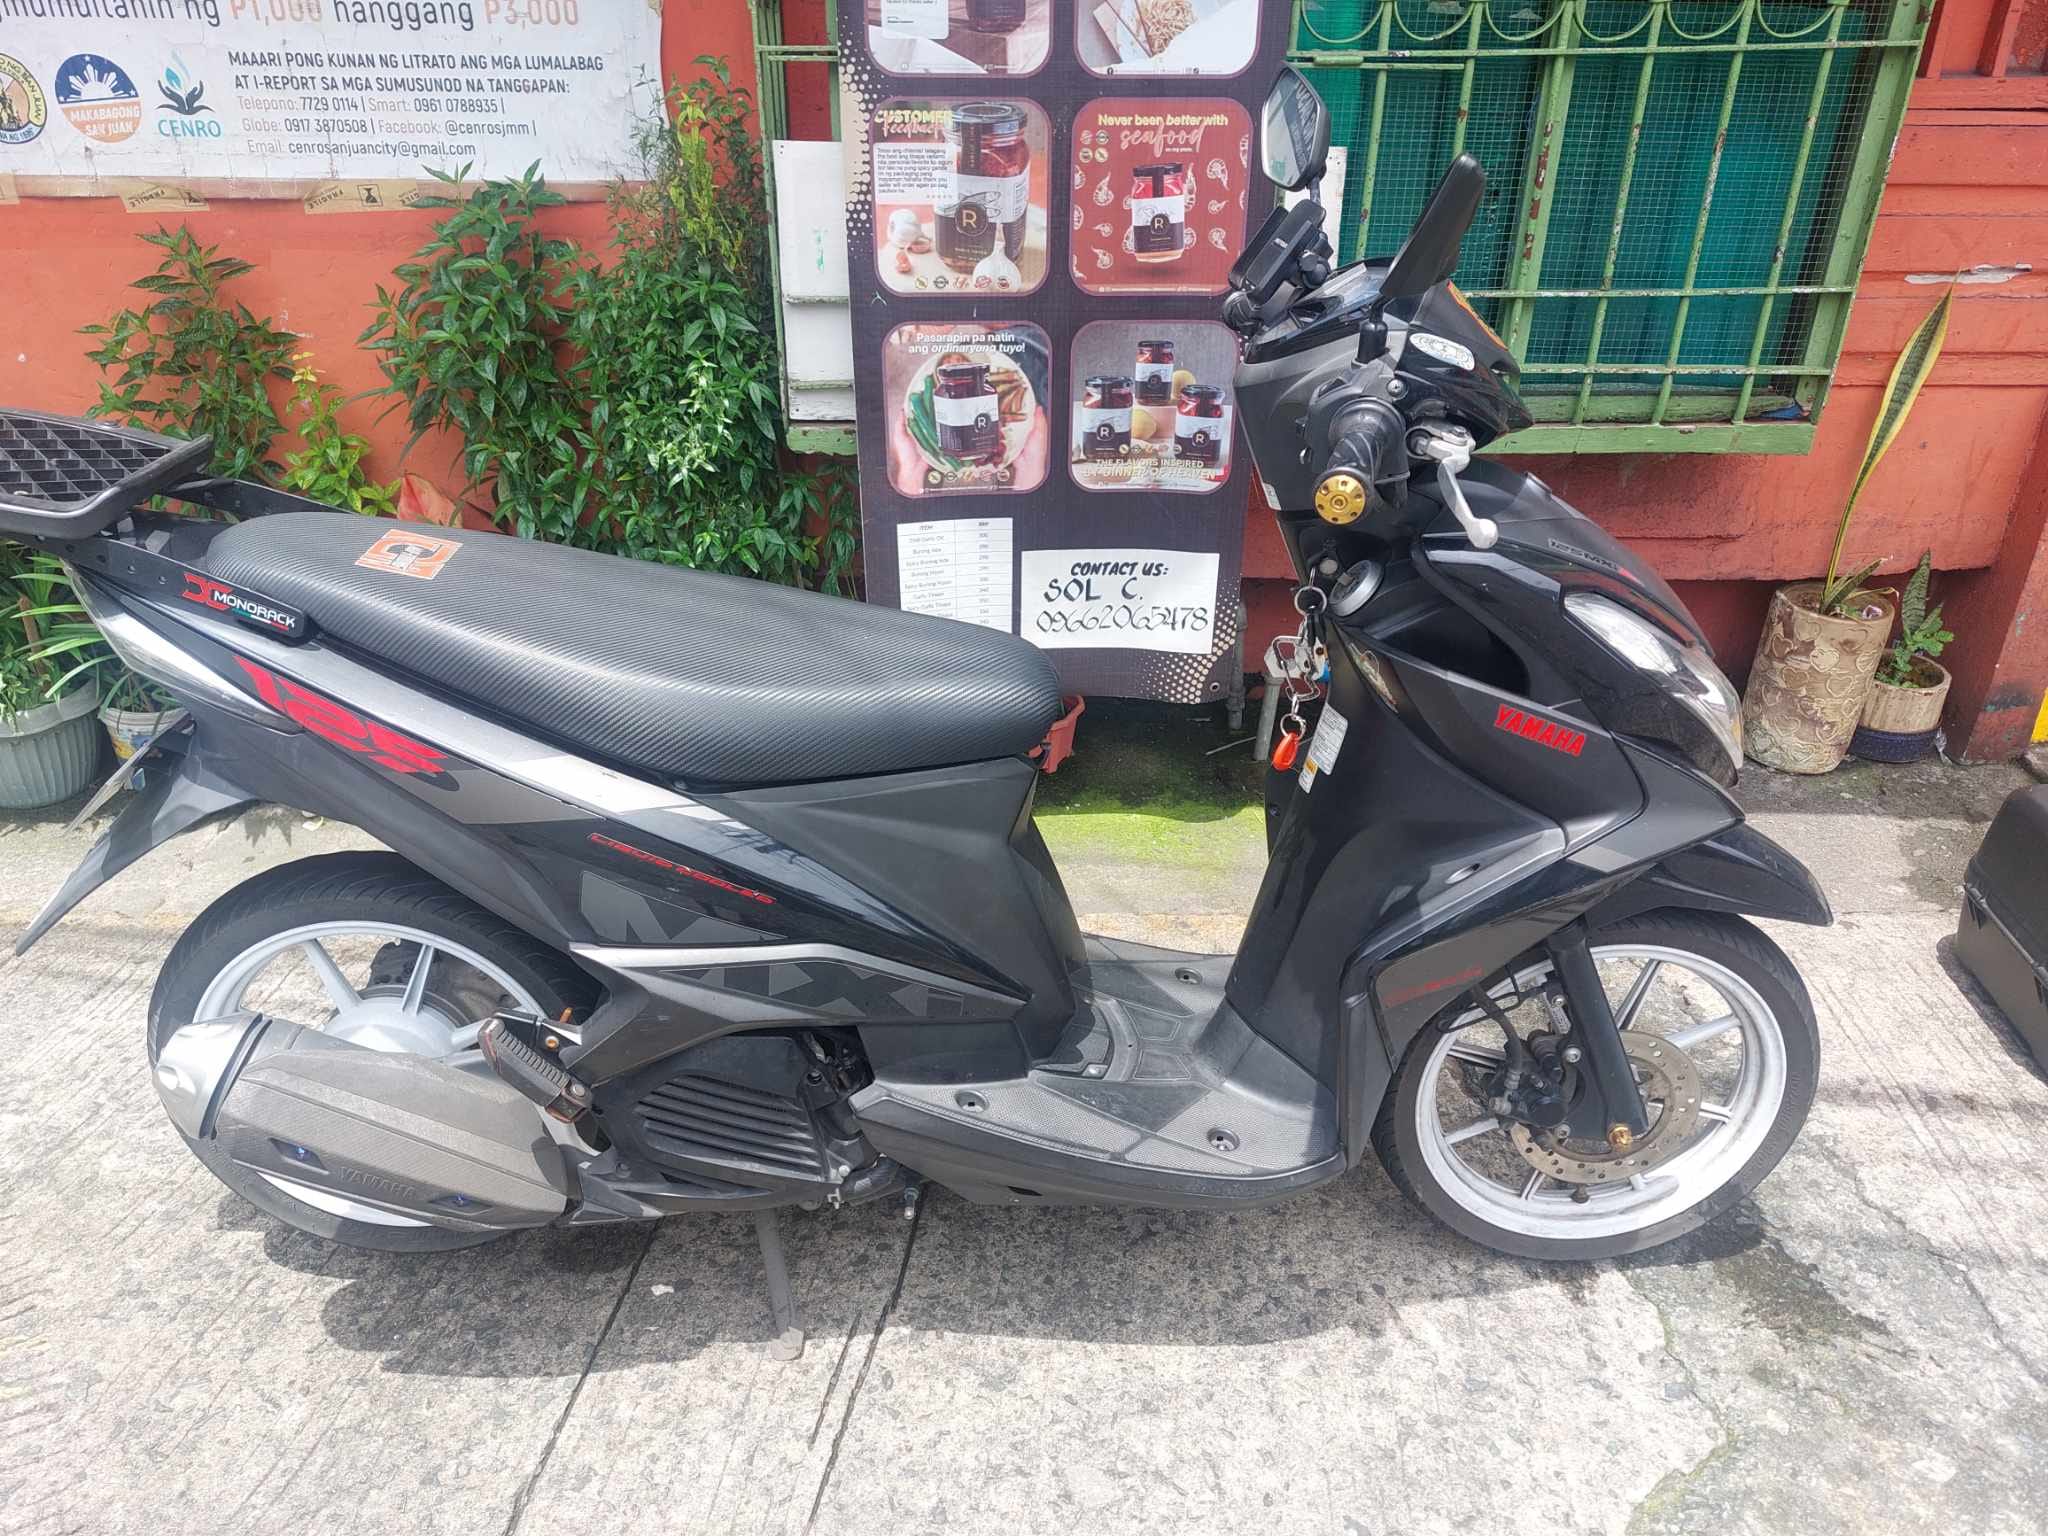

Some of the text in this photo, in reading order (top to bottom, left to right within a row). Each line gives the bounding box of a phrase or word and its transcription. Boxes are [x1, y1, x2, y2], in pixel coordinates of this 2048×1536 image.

[184, 0, 220, 27] ng
[334, 0, 474, 31] hanggang
[228, 51, 604, 71] MAAARI PONG KUNAN NG LITRATO ANG MGA LUMALABAG
[235, 75, 570, 94] AT I-REPORT SA MGA SUMUSUNOD NA TANGGAPAN:
[70, 105, 140, 122] MAKABAGONG
[300, 96, 329, 111] 7729
[333, 97, 359, 112] 0114
[369, 97, 411, 112] Smart:
[414, 98, 442, 113] 0961
[446, 98, 498, 113] 0788935
[86, 121, 133, 137] SAN JUAN
[158, 119, 222, 138] CENRO
[242, 118, 283, 133] Globe:
[284, 118, 311, 133] 0917
[314, 118, 368, 133] 3870508
[378, 119, 442, 134] Facebook:
[444, 119, 530, 138] @cenrosjmm
[1098, 114, 1229, 126] Never been better with
[288, 139, 476, 158] cenrosanjuancity@gmail.com
[1120, 122, 1205, 157] seafood
[962, 210, 977, 229] R
[1154, 217, 1164, 229] R
[917, 332, 1015, 345] Pasarapin pa natin
[908, 344, 929, 354] ang
[999, 342, 1026, 354] tuyo!
[978, 416, 987, 428] R
[1101, 426, 1109, 438] R
[1196, 434, 1205, 444] R
[1160, 458, 1205, 469] INSPIRED
[1071, 562, 1169, 577] CONTACT US:
[1043, 577, 1143, 602] SOL C.
[214, 590, 296, 628] MONORACK
[1036, 604, 1208, 633] 09662065478
[1494, 703, 1585, 757] YAMAHA
